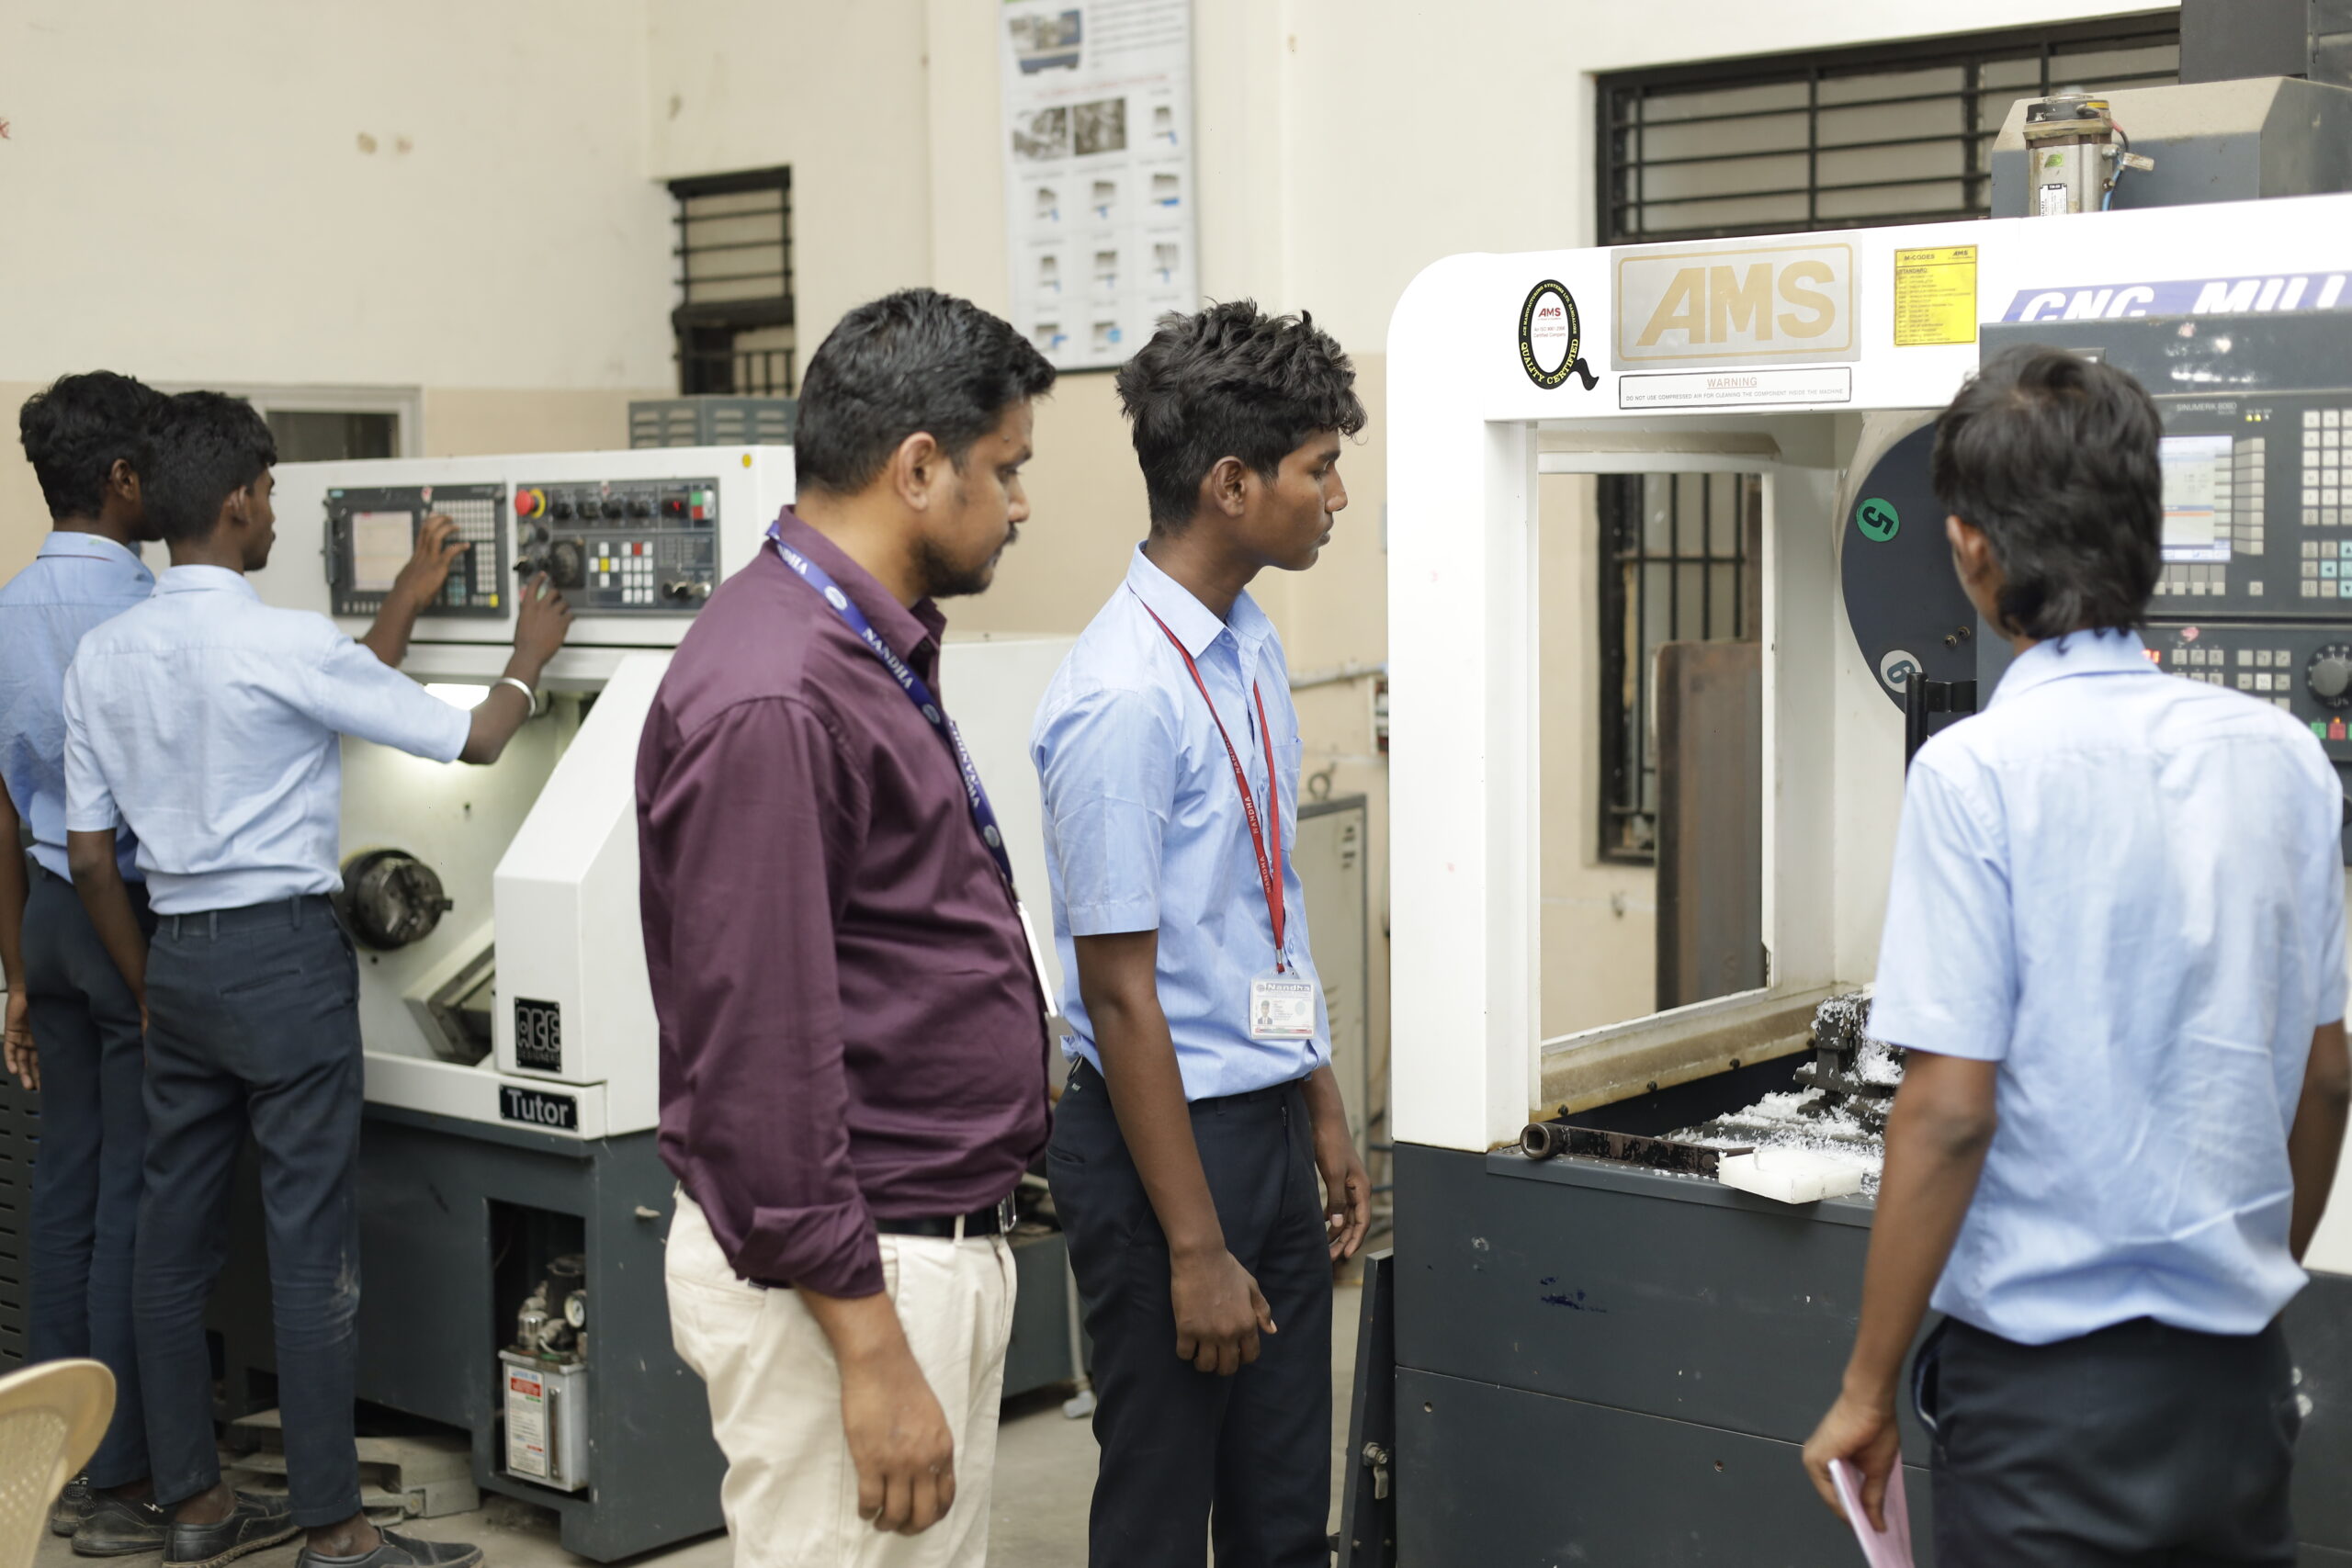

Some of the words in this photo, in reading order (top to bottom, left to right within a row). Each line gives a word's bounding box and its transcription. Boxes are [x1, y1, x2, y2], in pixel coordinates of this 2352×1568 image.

[1538, 307, 1562, 318] AMS
[1544, 282, 1565, 295] SYSTEMS
[1567, 303, 1577, 334] BANGALORE
[1635, 259, 1837, 347] AMS
[1521, 342, 1545, 383] QUALITY
[1546, 338, 1579, 385] CERTIFIED
[1707, 377, 1758, 388] WARNING
[1862, 506, 1894, 536] 5
[861, 627, 913, 689] NANDHA
[1244, 795, 1260, 835] NANDHA
[1260, 855, 1272, 894] NANDHA
[1268, 984, 1310, 992] Nandha
[507, 1089, 570, 1126] Tutor
